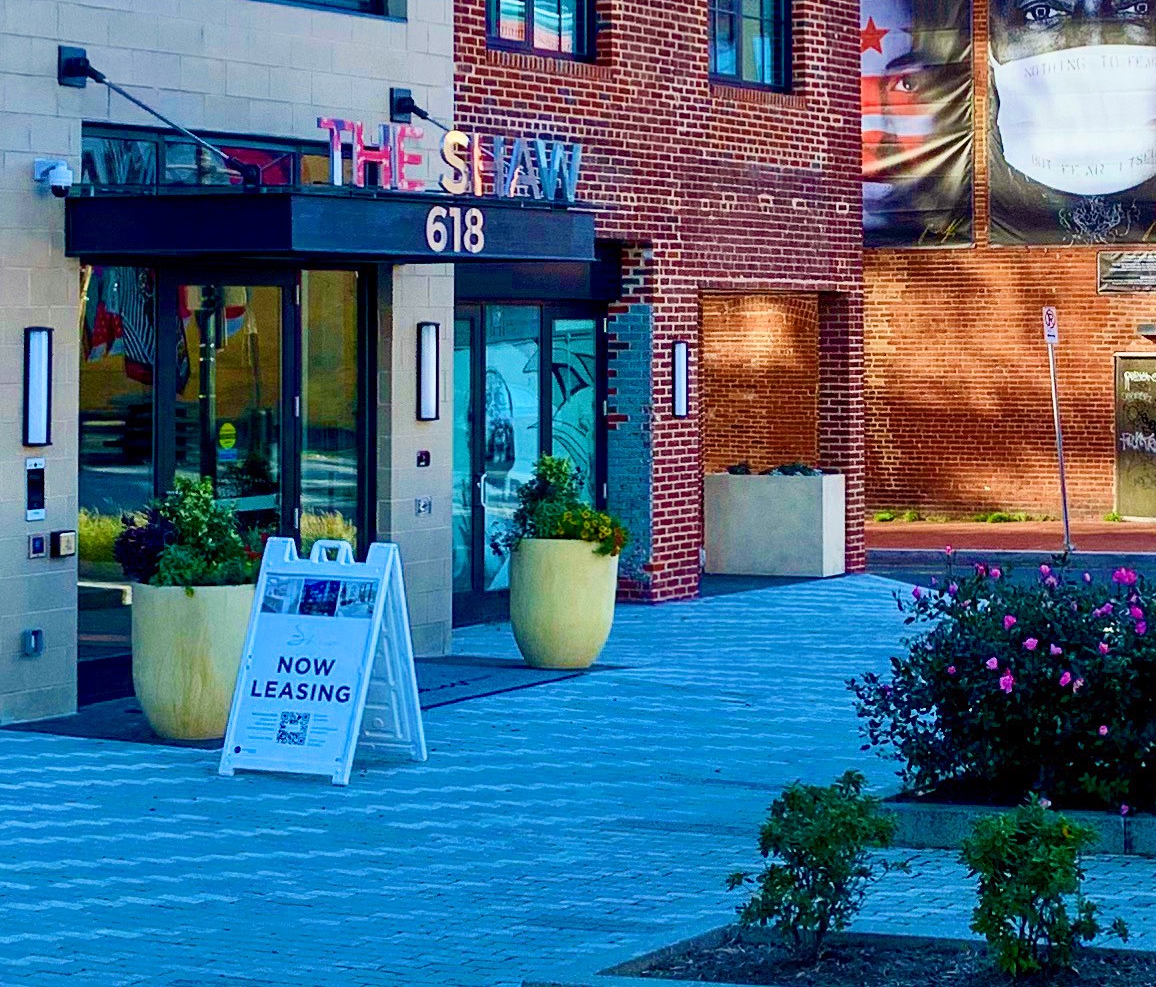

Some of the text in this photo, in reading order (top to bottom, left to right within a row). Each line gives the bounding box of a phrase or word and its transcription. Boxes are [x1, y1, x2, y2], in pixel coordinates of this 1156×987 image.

[316, 116, 583, 203] THE SHAW
[426, 205, 486, 254] 618
[276, 656, 336, 676] NOW
[250, 679, 351, 703] LEASING
